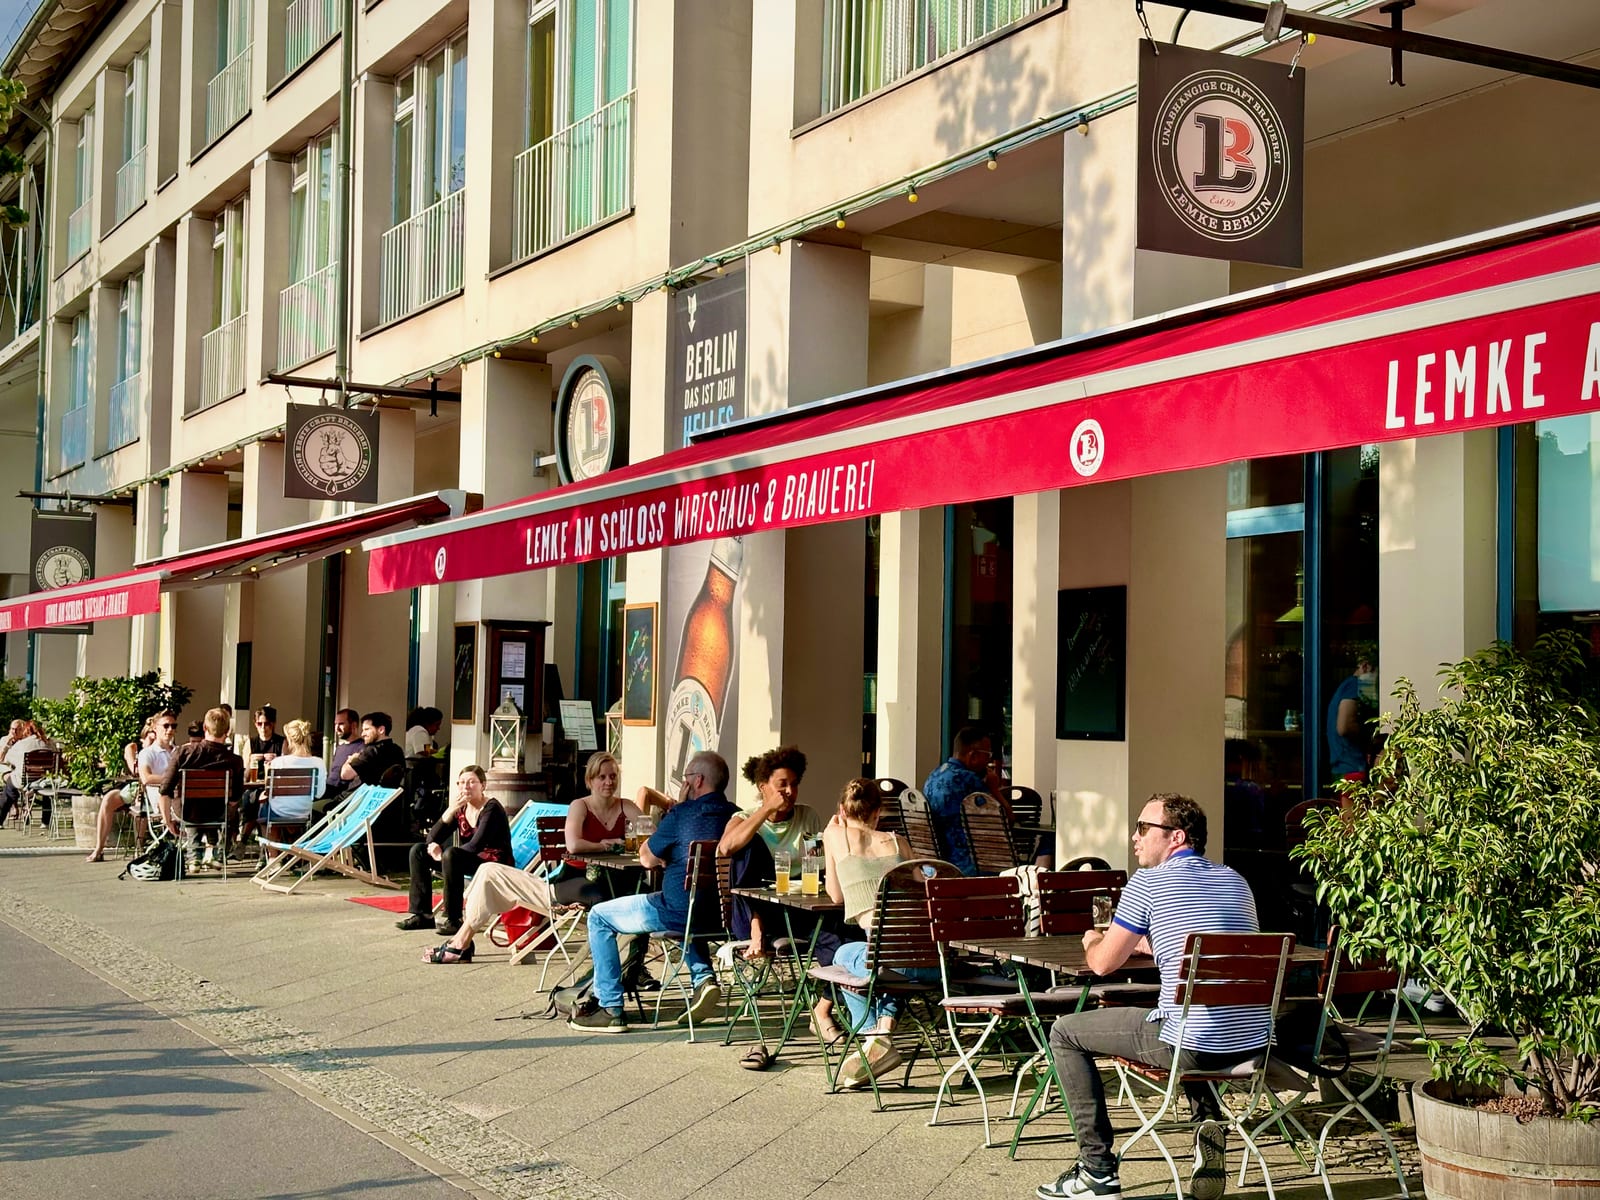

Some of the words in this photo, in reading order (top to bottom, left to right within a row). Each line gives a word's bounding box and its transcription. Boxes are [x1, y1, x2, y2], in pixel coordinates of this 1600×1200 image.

[1219, 81, 1255, 105] CRAFT
[1252, 101, 1281, 165] BRAUEREI
[1170, 183, 1218, 230] LEMKE
[1222, 195, 1272, 232] BERLIN
[685, 329, 738, 384] BERLIN
[1385, 331, 1547, 430] LEMKE
[684, 388, 699, 410] DAS
[701, 382, 714, 406] IST
[717, 375, 736, 402] DEIN
[310, 416, 337, 428] CRAFT
[337, 417, 369, 450] BRAUEREI
[526, 520, 569, 565] LEMKE
[574, 515, 594, 557] AM
[600, 501, 667, 552] SCHLOSS
[674, 482, 760, 540] WIRTSHAUS
[763, 478, 777, 524] &
[781, 458, 876, 521] BRAUEREI
